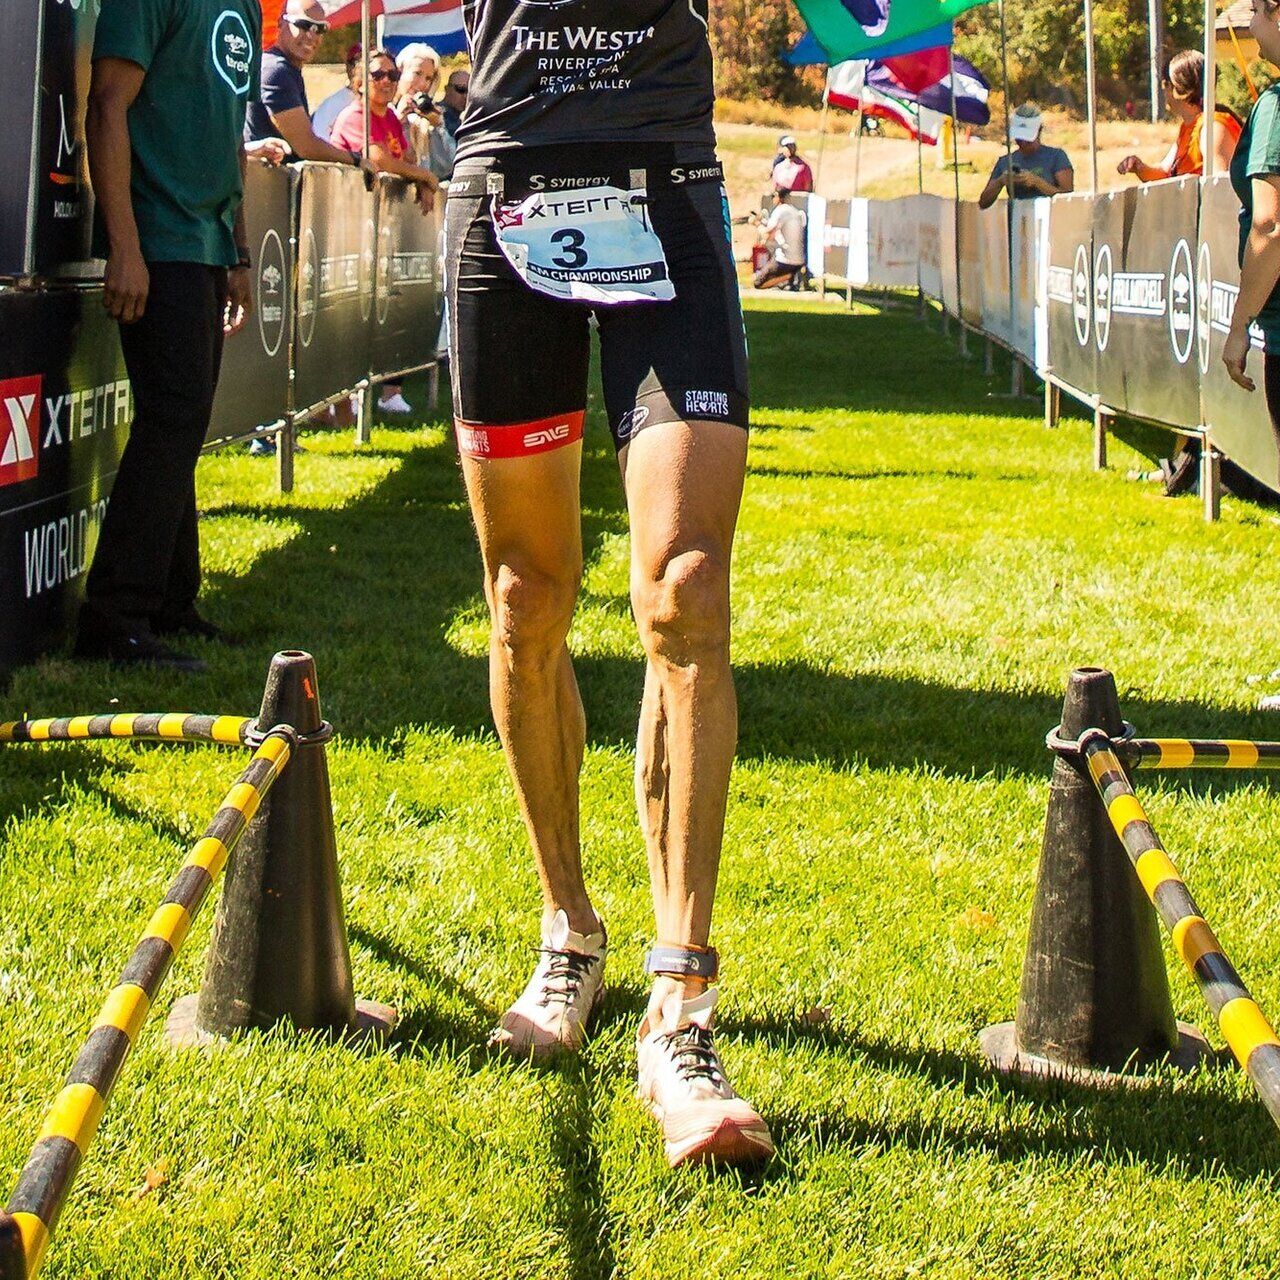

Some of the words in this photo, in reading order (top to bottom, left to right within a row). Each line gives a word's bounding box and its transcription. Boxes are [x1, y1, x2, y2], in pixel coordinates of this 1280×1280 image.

[589, 79, 632, 90] VALLEY
[550, 176, 610, 188] synergy
[549, 227, 590, 269] 3
[550, 268, 652, 282] CHAMPIONSHIP
[685, 390, 728, 404] STARTING
[42, 379, 131, 449] XTERRA
